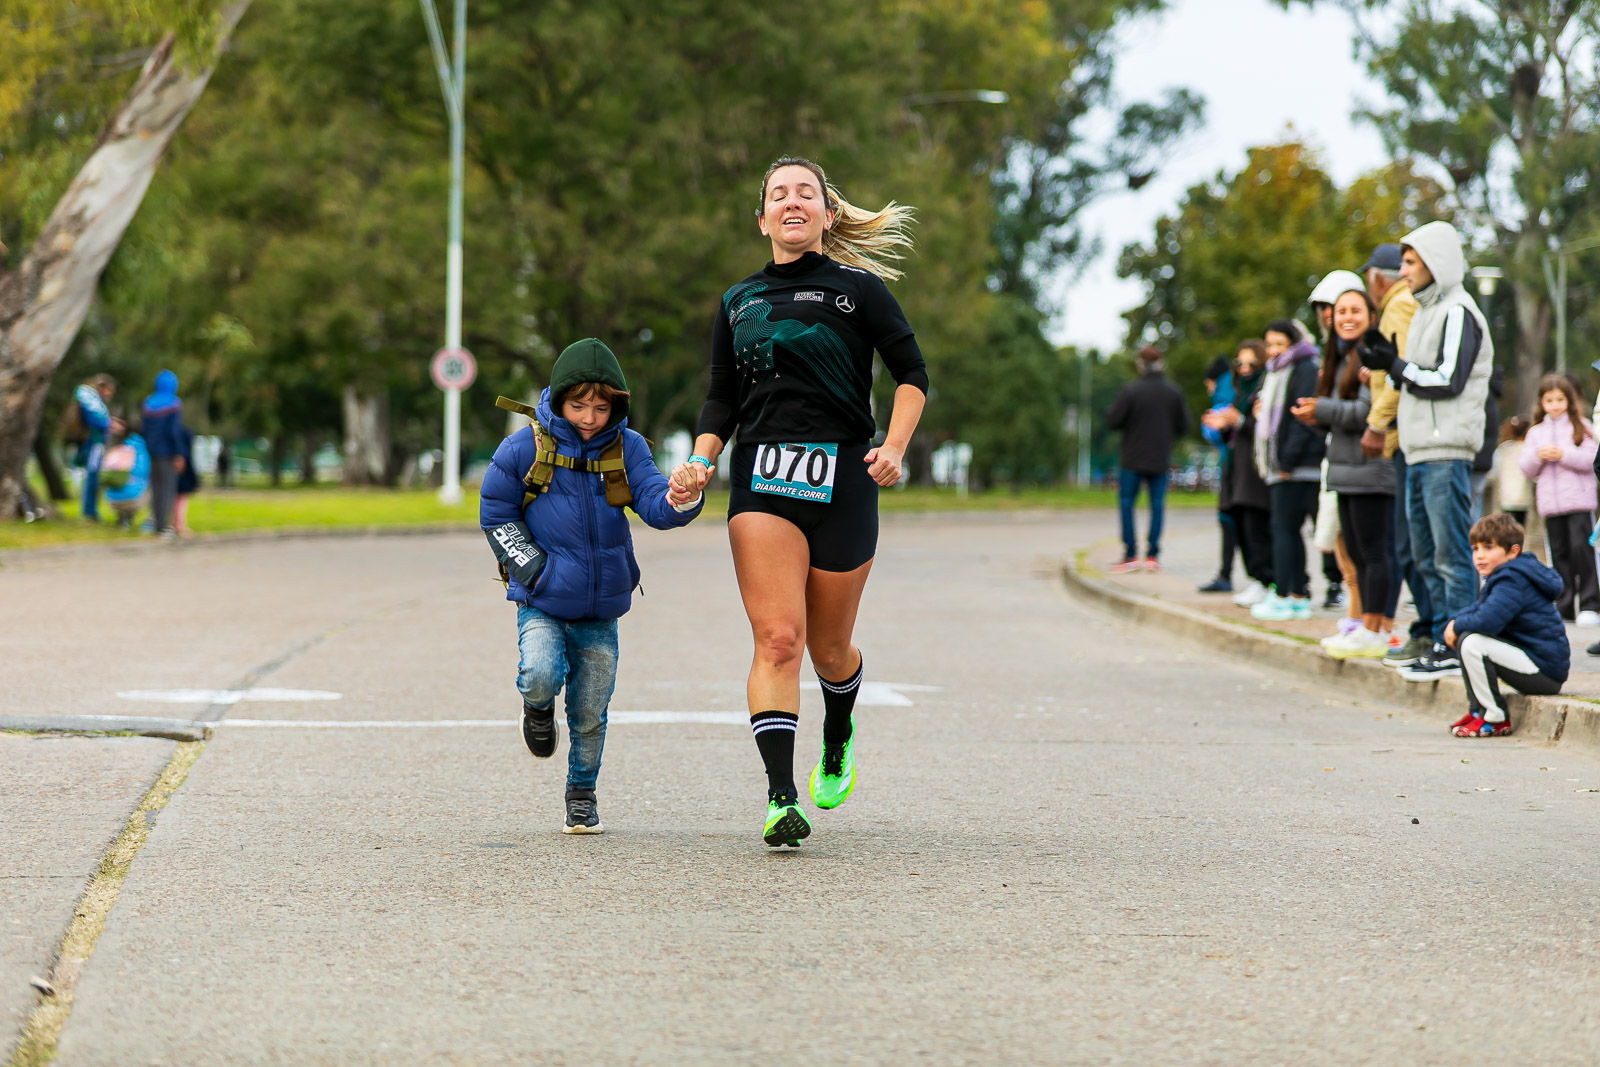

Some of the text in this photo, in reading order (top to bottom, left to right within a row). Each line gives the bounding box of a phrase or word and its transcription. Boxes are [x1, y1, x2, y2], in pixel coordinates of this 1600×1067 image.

[760, 443, 828, 488] 070
[754, 482, 828, 500] DIAMANTE CORRE
[492, 528, 531, 568] BATIC
